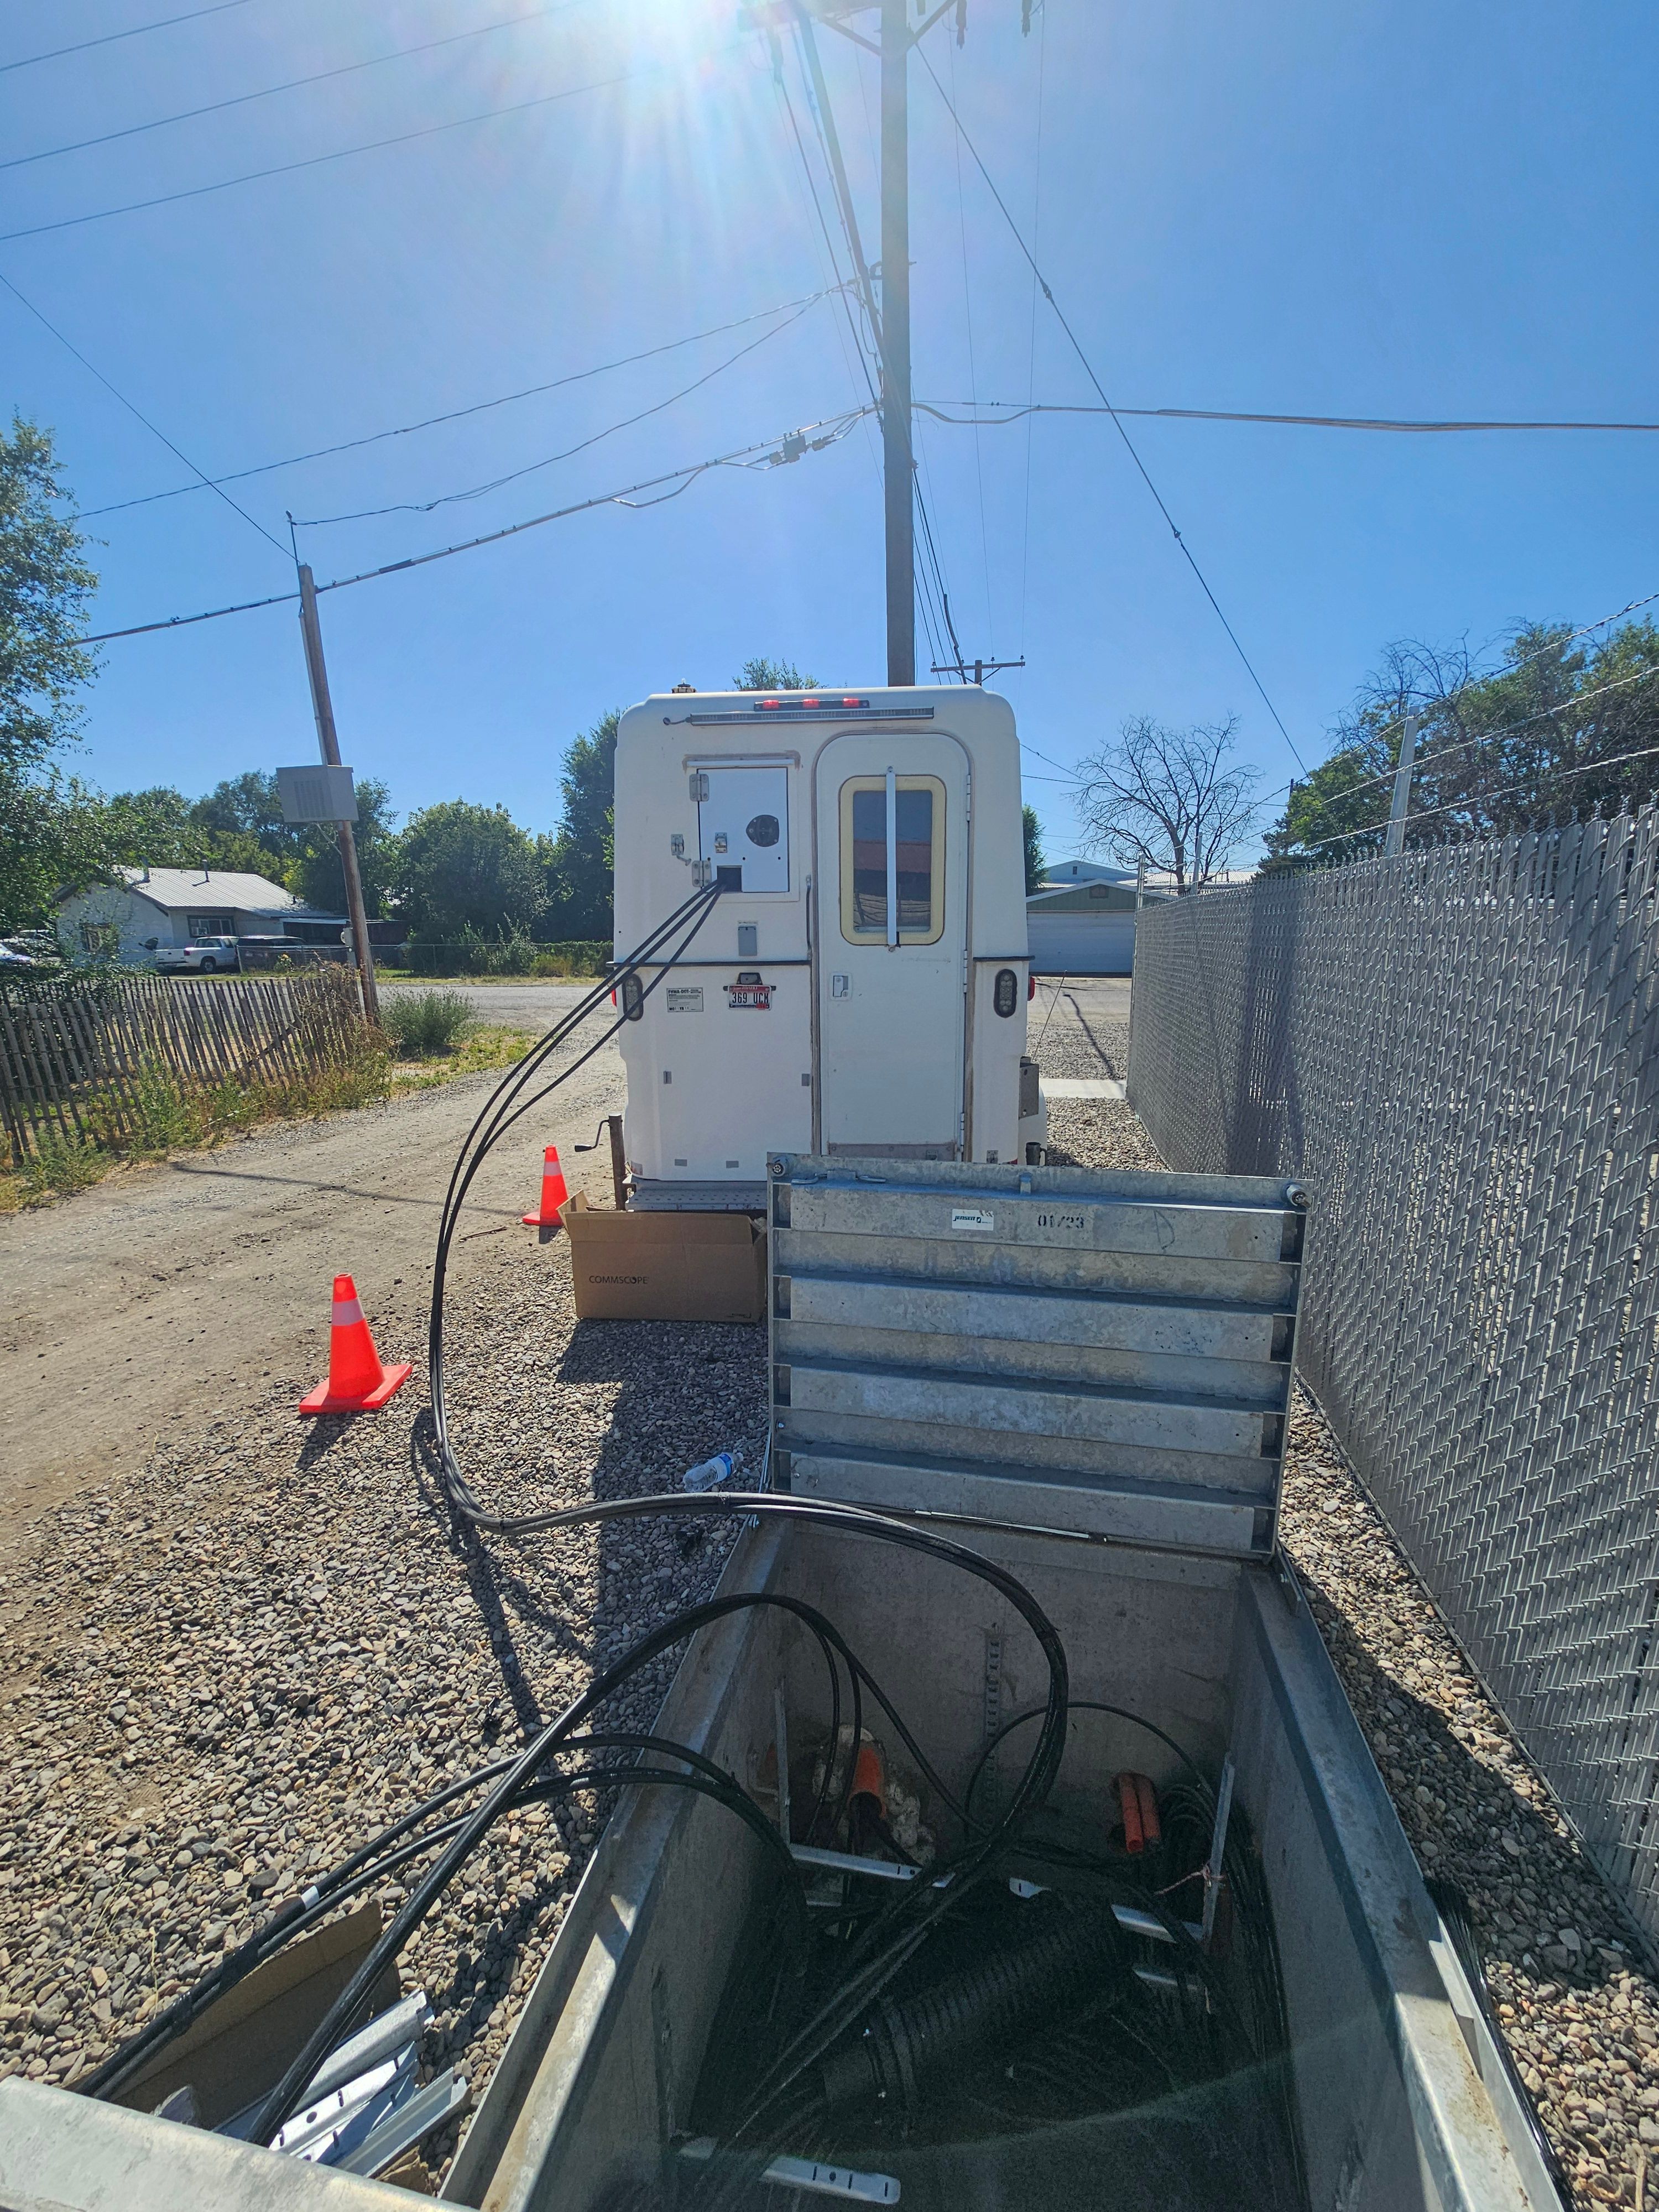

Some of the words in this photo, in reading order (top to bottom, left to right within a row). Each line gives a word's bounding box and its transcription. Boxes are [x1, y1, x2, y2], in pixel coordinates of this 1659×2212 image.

[732, 992, 747, 1003] 369
[1038, 1214, 1085, 1229] 01/23
[589, 1275, 649, 1284] COMMSCOPE
